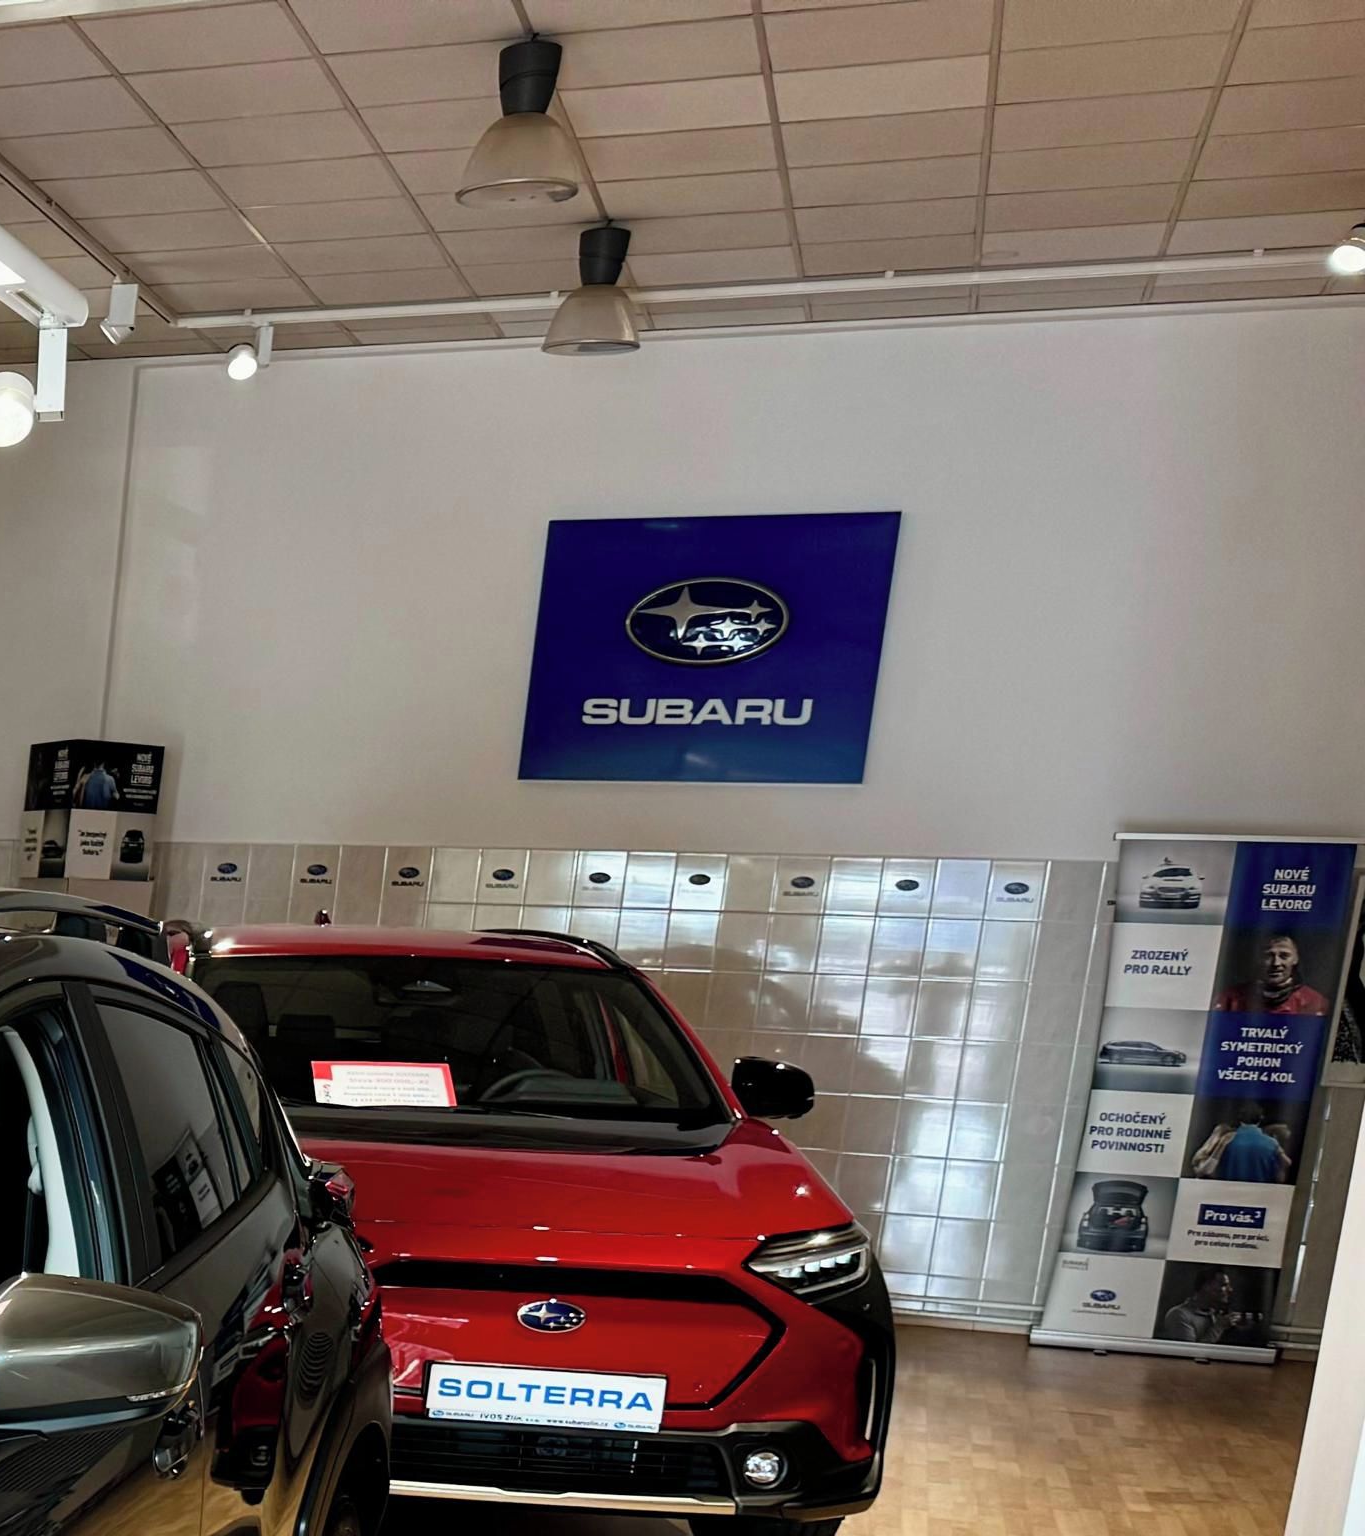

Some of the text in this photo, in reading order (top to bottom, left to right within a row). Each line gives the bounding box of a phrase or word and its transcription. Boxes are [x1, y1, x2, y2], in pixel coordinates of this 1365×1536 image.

[582, 698, 814, 727] SUBARU
[1274, 866, 1310, 881] NOVÉ
[1262, 883, 1317, 897] SUBARU
[1261, 898, 1313, 911] LEVORG
[1131, 948, 1189, 961] ZROZENÝ
[1124, 964, 1193, 976] PRO RALLY
[1240, 1026, 1289, 1039] TRVALÝ
[1220, 1041, 1304, 1055] SYMETRICKÝ
[1236, 1056, 1281, 1068] POHON
[1217, 1067, 1296, 1083] VŠECH 4 KOL
[1099, 1111, 1167, 1125] OCHOČENÝ
[1089, 1125, 1172, 1140] PRO RODINNÉ
[1091, 1139, 1165, 1153] POVINNOSTI
[1204, 1209, 1228, 1222] Pro
[438, 1378, 654, 1412] SOLTERRA
[479, 1413, 503, 1421] IVOS
